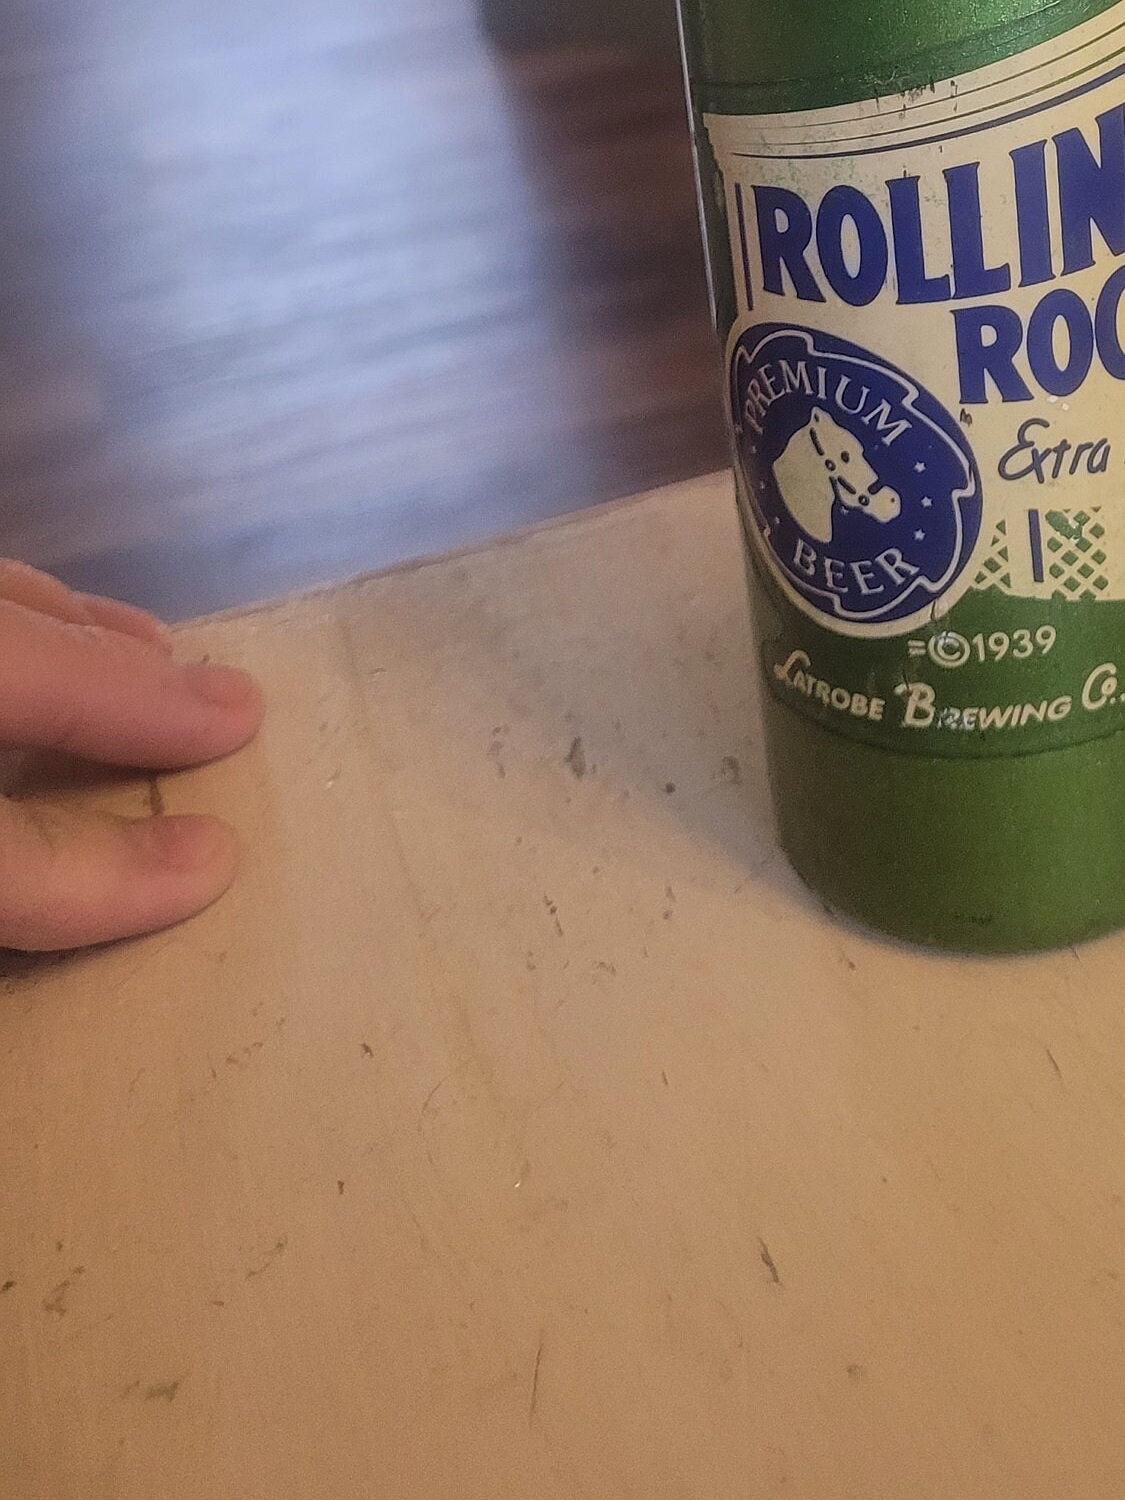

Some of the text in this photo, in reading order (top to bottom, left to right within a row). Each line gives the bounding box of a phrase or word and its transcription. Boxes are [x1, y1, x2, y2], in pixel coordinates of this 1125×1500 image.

[744, 359, 913, 446] PREMIUM
[998, 417, 1111, 484] Extra
[793, 539, 920, 595] BEER
